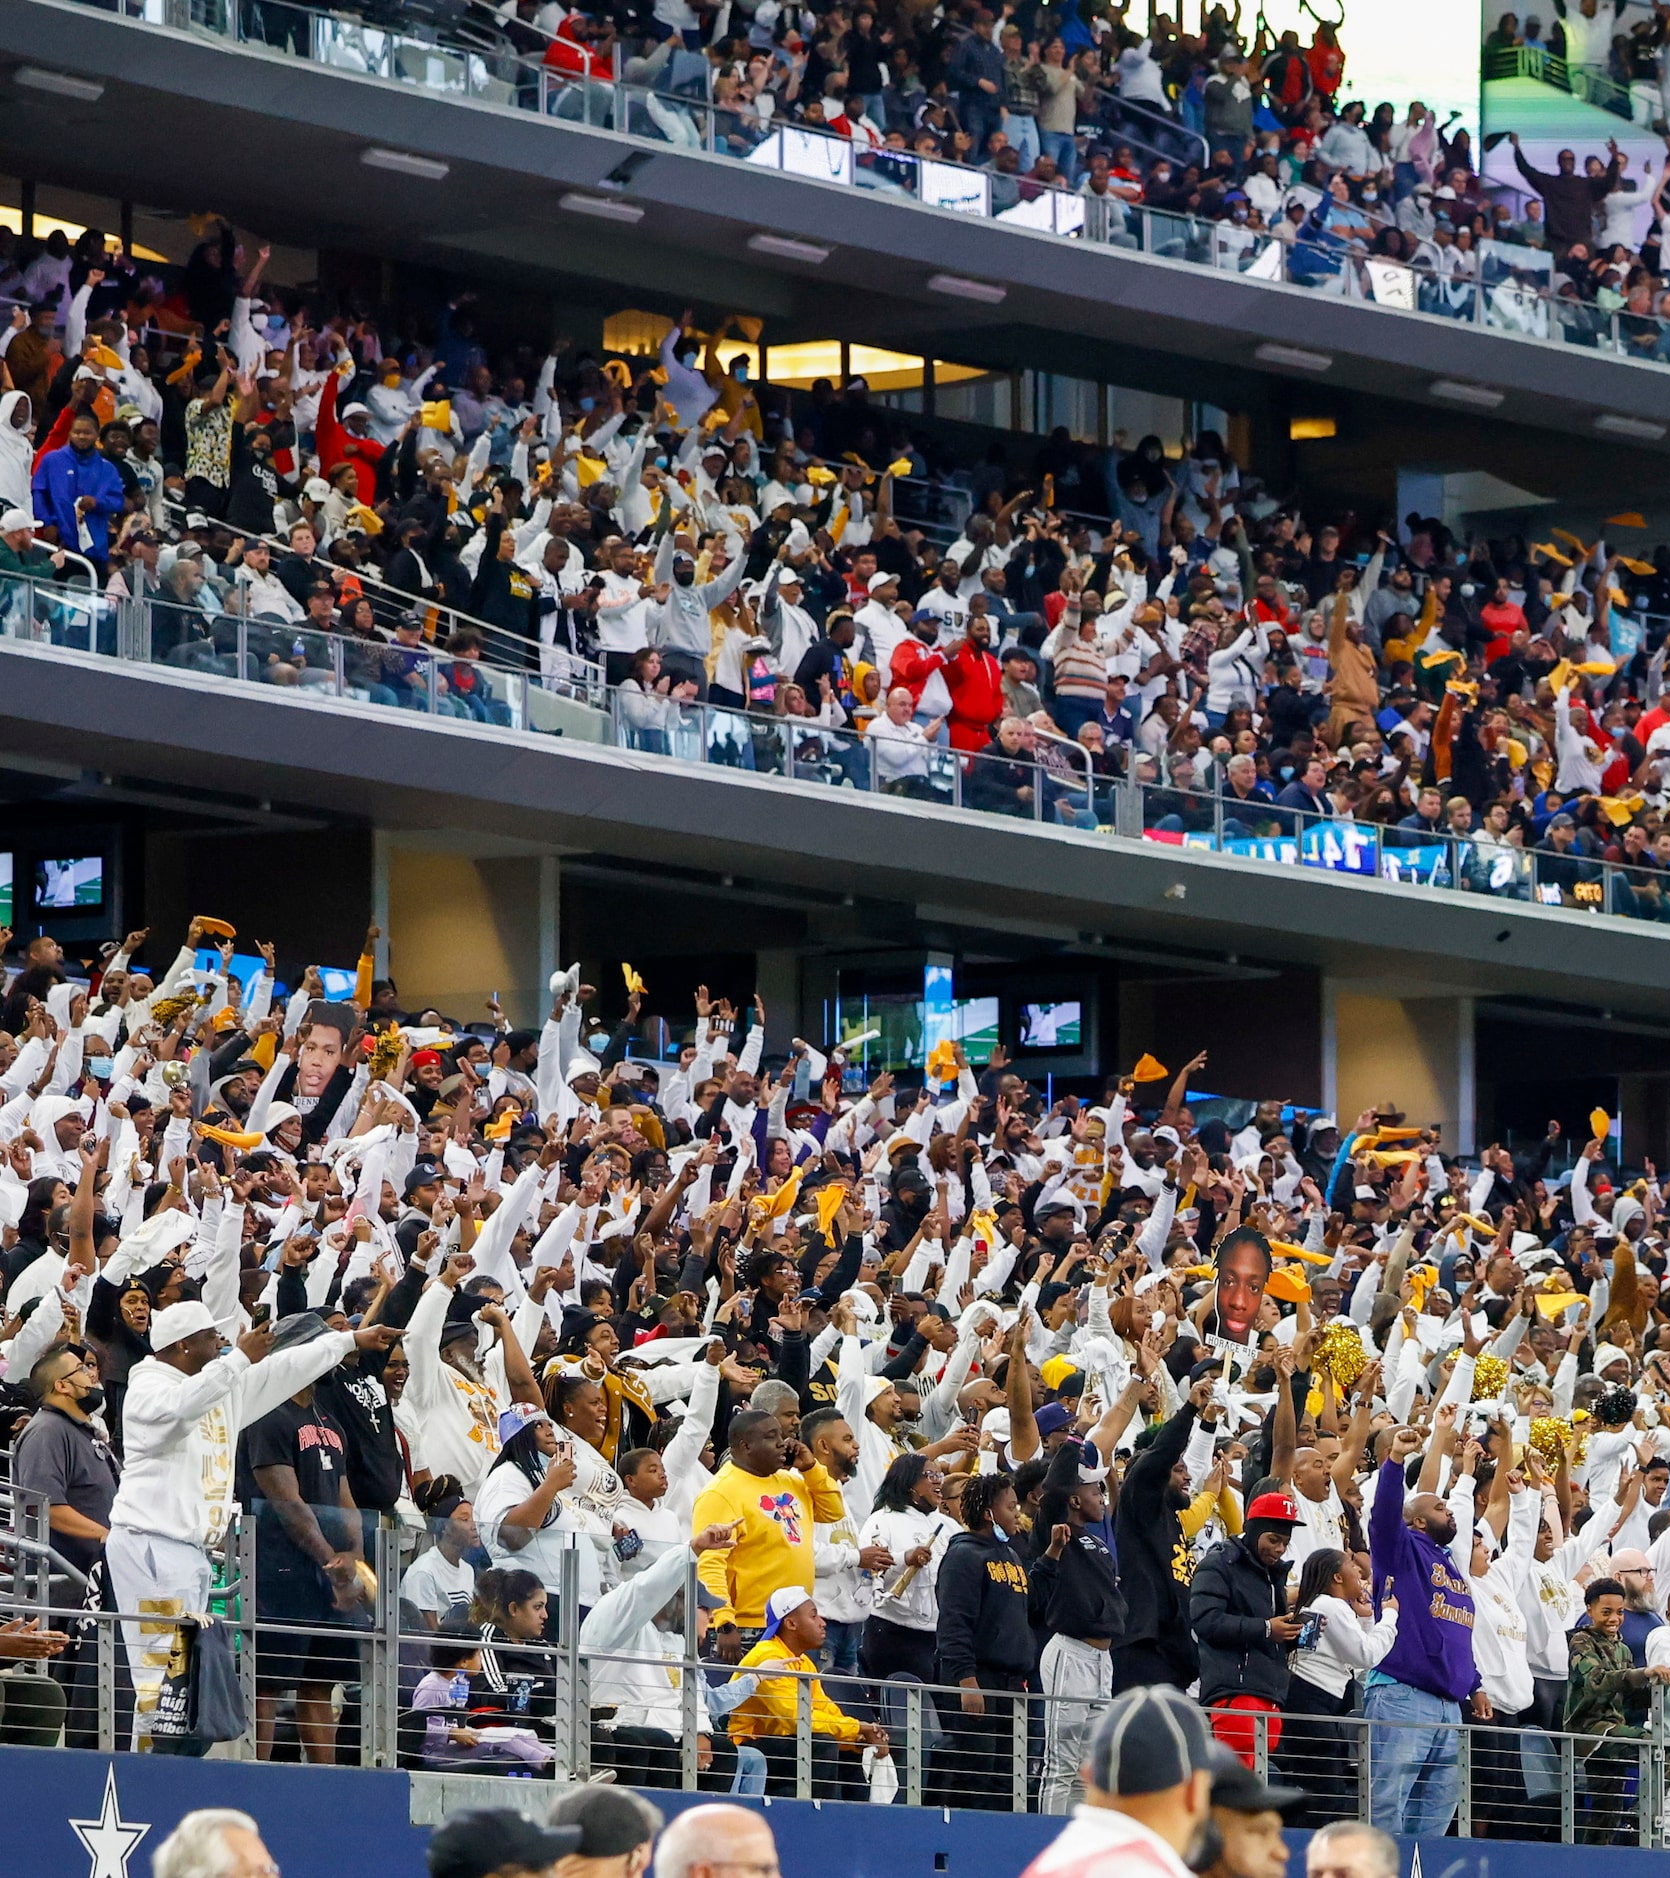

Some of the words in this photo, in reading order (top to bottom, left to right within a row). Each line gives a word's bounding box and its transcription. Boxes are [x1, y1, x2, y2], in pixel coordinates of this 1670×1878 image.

[1208, 1336, 1240, 1354] HORACE
[1242, 1346, 1256, 1358] #16
[1282, 1500, 1293, 1515] T
